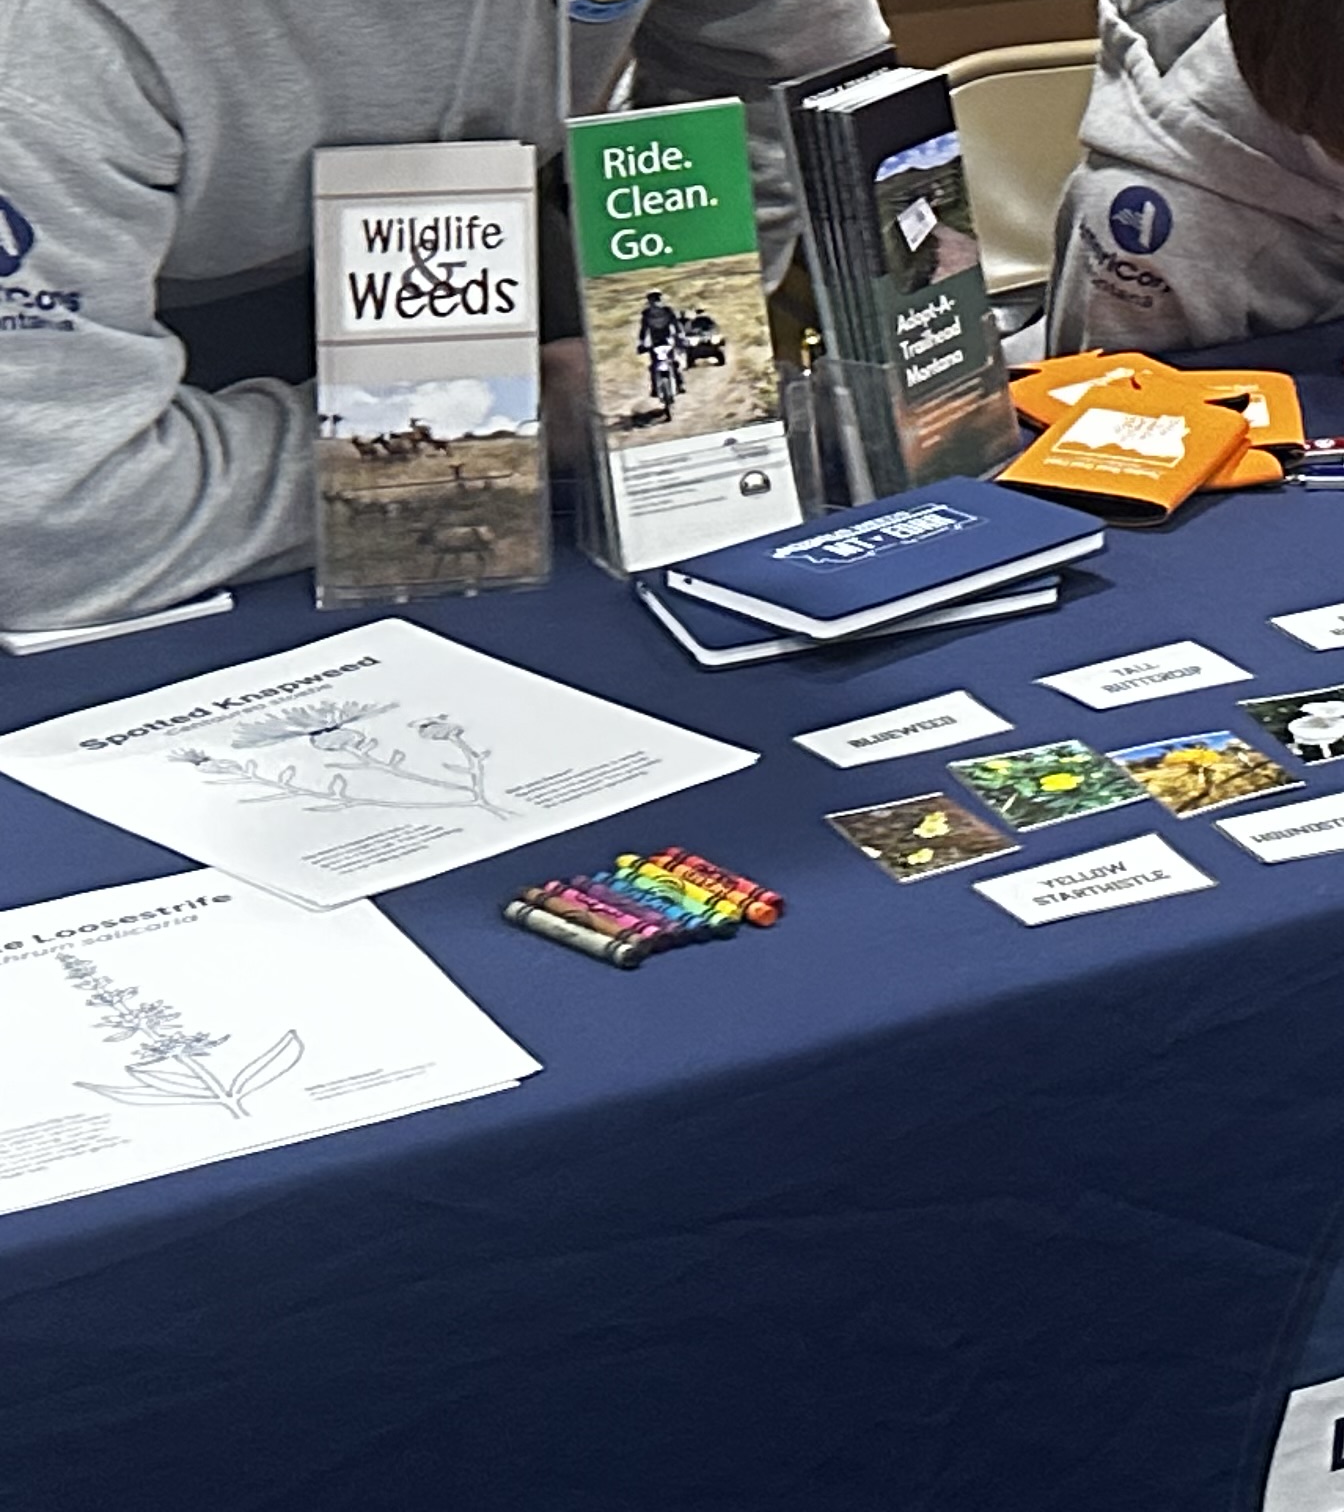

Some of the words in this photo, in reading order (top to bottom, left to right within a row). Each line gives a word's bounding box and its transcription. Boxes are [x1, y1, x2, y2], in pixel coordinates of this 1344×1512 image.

[602, 142, 693, 181] Ride.
[605, 182, 720, 222] Clean.
[361, 215, 505, 255] Wildlife
[610, 227, 674, 261] Go.
[402, 240, 467, 296] &
[347, 267, 518, 321] Weeds
[906, 350, 964, 388] Montana
[1100, 665, 1203, 694] BUTTERCUP
[1110, 662, 1161, 677] TALL
[79, 706, 212, 751] Spotted
[212, 656, 381, 710] Knapweed
[846, 715, 958, 749] BLUEWEED
[1031, 869, 1172, 906] STARTHISTLE
[1037, 860, 1128, 889] YELLOW
[32, 894, 232, 944] Loosestrife
